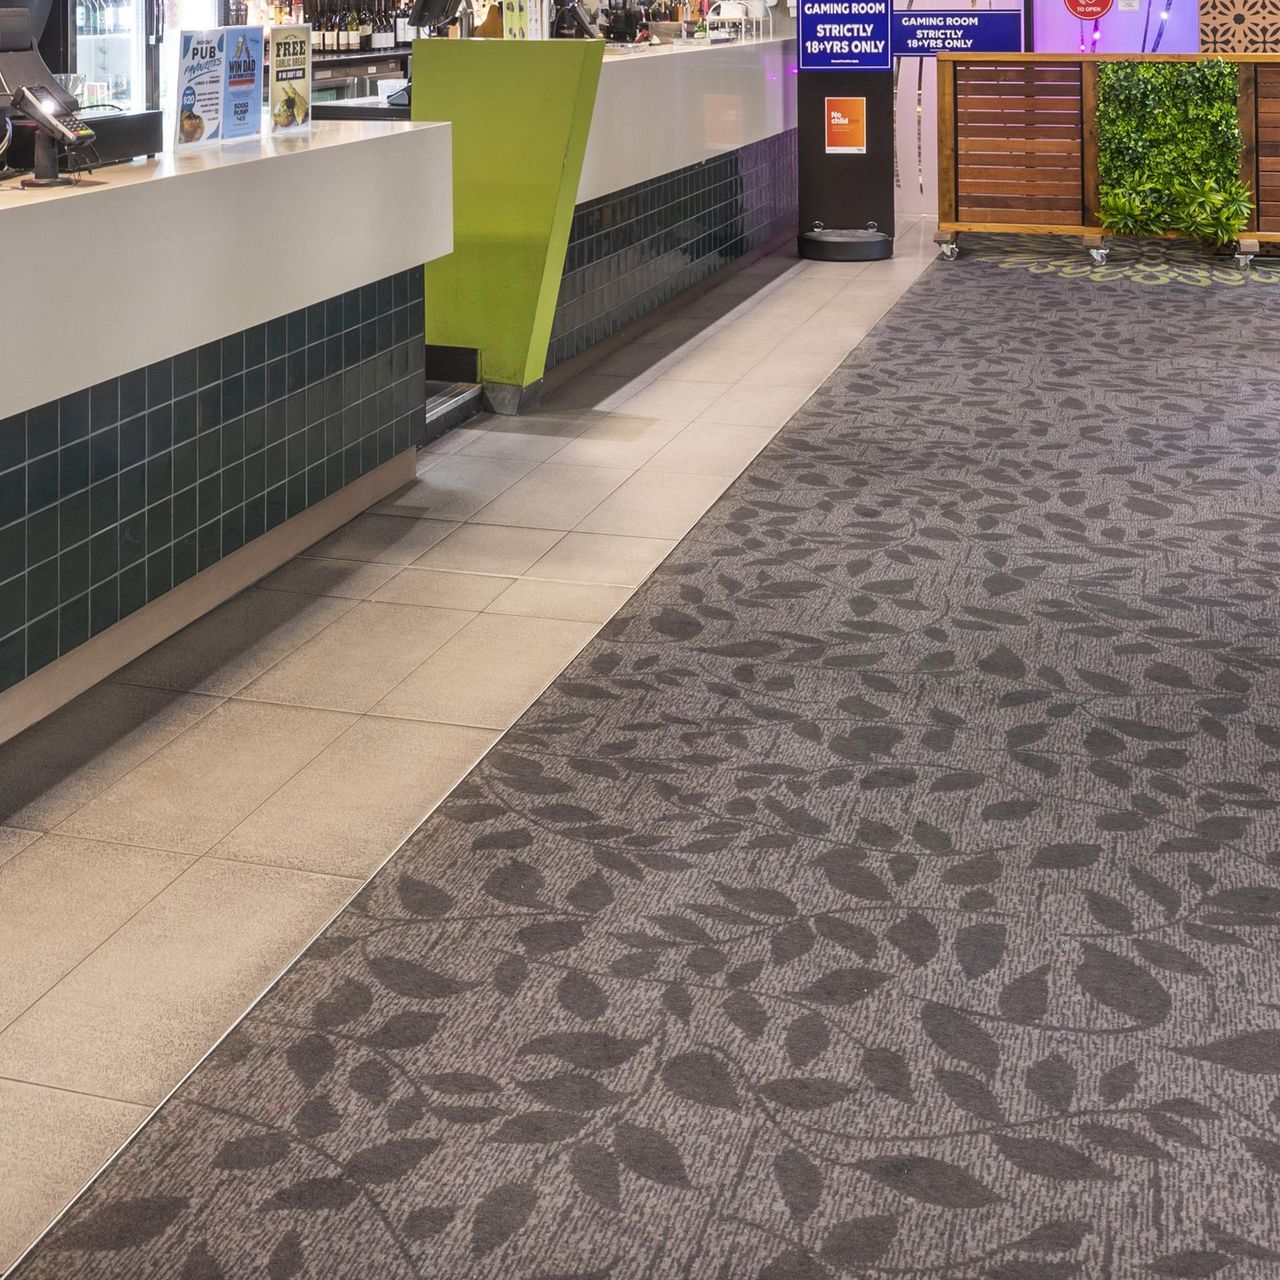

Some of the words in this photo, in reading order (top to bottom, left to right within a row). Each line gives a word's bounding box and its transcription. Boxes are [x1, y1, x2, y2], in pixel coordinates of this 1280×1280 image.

[804, 3, 849, 14] GAMING
[852, 2, 885, 14] ROOM
[902, 17, 944, 26] GAMING
[946, 17, 978, 26] ROOM
[816, 24, 873, 37] STRICTLY
[916, 30, 963, 38] STRICTLY
[276, 41, 306, 57] FREE
[806, 41, 849, 53] 18+YRS
[852, 40, 885, 53] ONLY
[907, 40, 942, 48] 18+YRS
[944, 39, 973, 48] ONLY
[192, 46, 216, 60] PUB
[184, 58, 222, 76] FAVOURITES
[229, 60, 241, 75] WIN
[243, 60, 256, 74] DAD
[276, 58, 291, 68] GARLIC
[292, 57, 306, 67] BREAD
